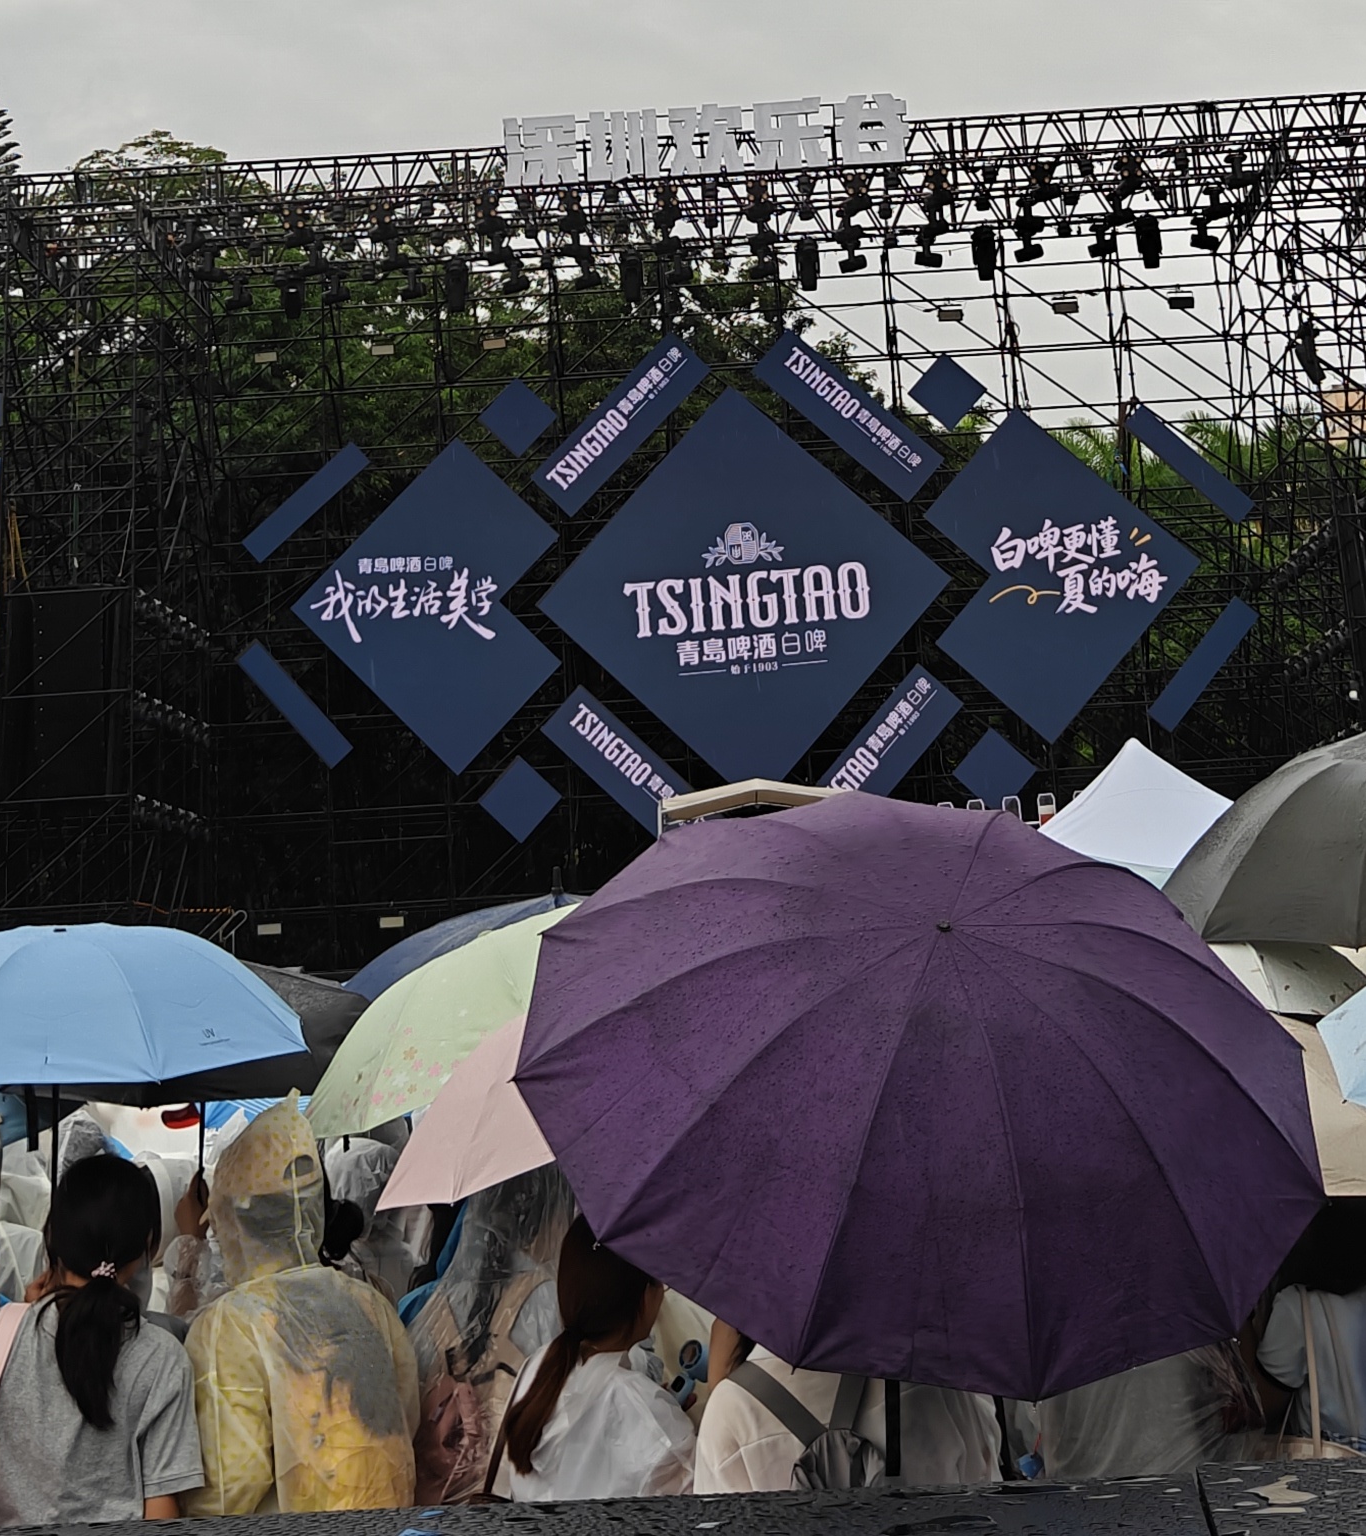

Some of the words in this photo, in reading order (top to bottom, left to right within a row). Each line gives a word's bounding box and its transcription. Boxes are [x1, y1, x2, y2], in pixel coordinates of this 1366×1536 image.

[502, 93, 912, 186] 深圳欢乐谷
[784, 346, 861, 419] TSINGTAO
[545, 408, 628, 491] TSINGTAO
[991, 515, 1122, 574] 白啤更懂
[310, 567, 498, 644] 我的生活美学
[623, 561, 871, 639] TSINGTAO
[1055, 553, 1168, 614] 夏的嗨
[569, 703, 652, 786] TSINGTAO
